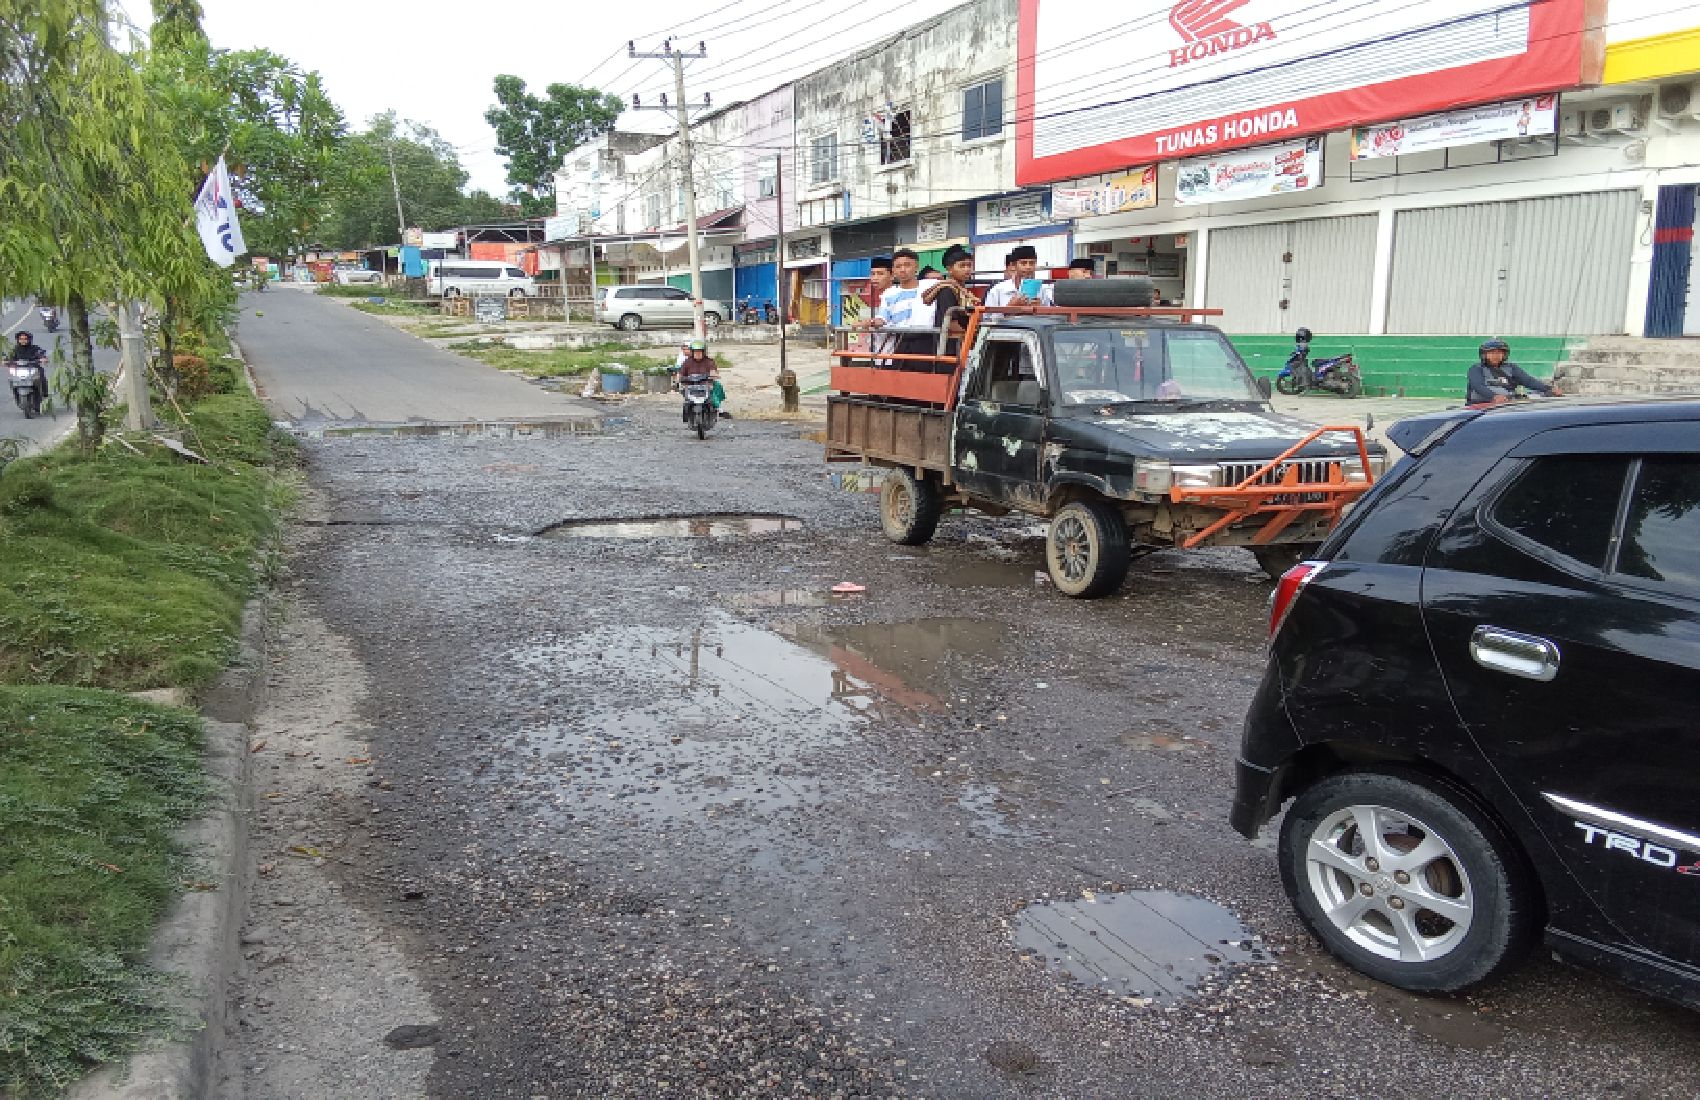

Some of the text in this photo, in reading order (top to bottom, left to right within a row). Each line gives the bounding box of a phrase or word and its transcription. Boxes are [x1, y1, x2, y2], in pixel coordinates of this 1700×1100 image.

[1168, 22, 1277, 68] HONDA
[1155, 108, 1299, 154] TUNAS HONDA
[1574, 821, 1676, 867] TRD
